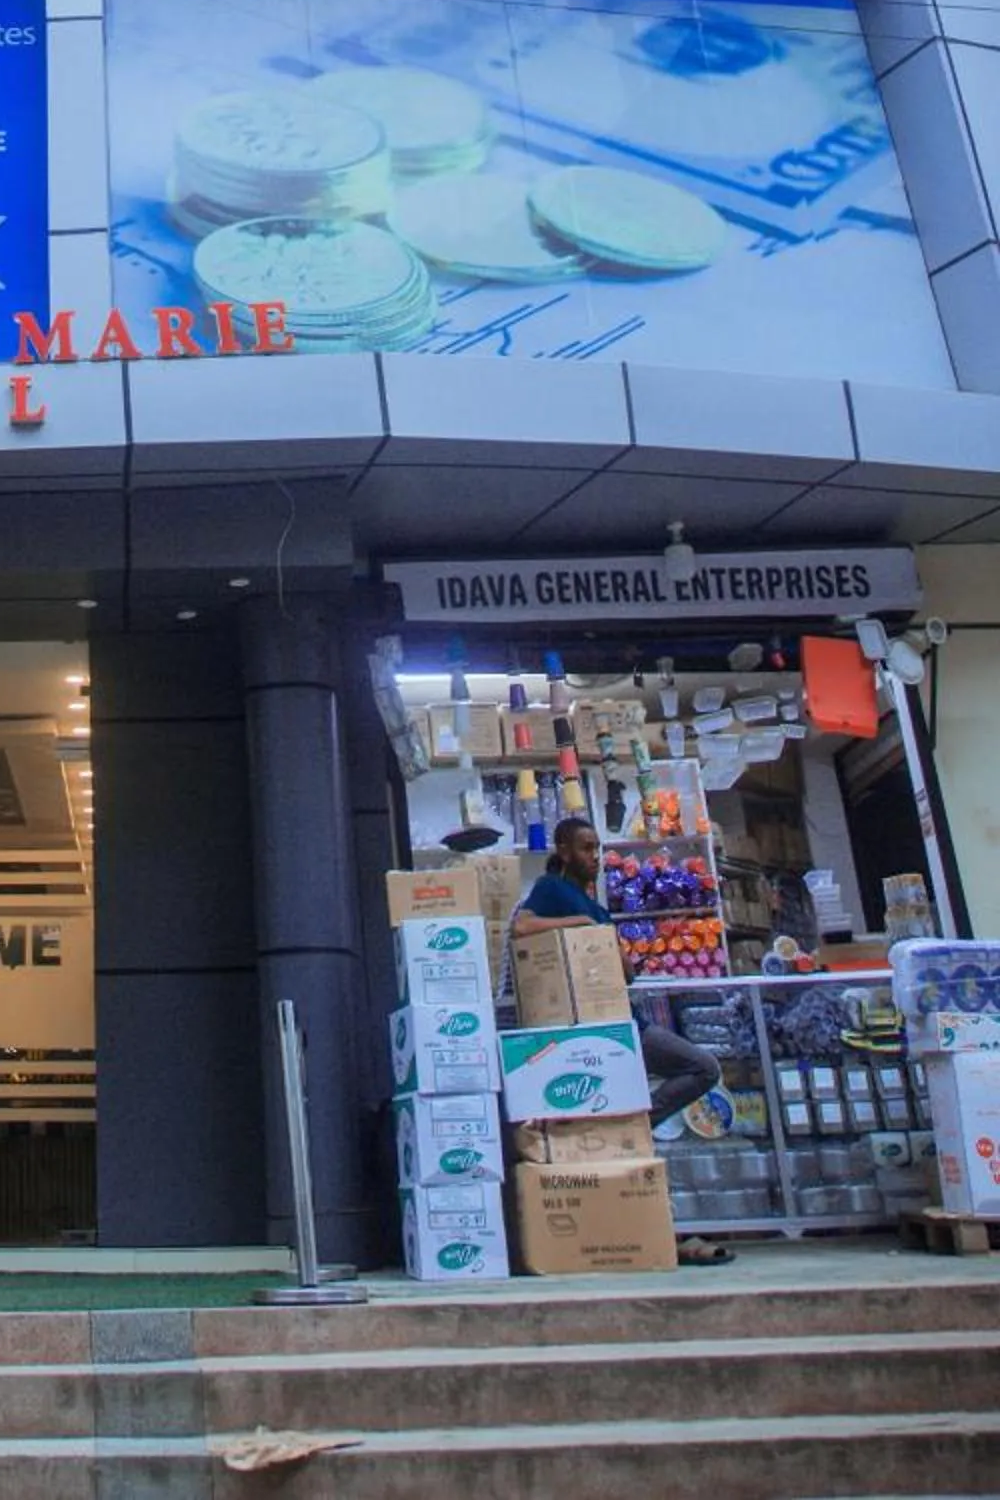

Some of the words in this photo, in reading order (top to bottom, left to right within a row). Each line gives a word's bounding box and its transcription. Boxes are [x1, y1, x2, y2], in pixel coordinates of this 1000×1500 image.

[14, 300, 296, 366] MARIE
[437, 573, 529, 610] IDAVA
[535, 569, 668, 606] GENERAL
[674, 565, 872, 601] ENTERPRISES
